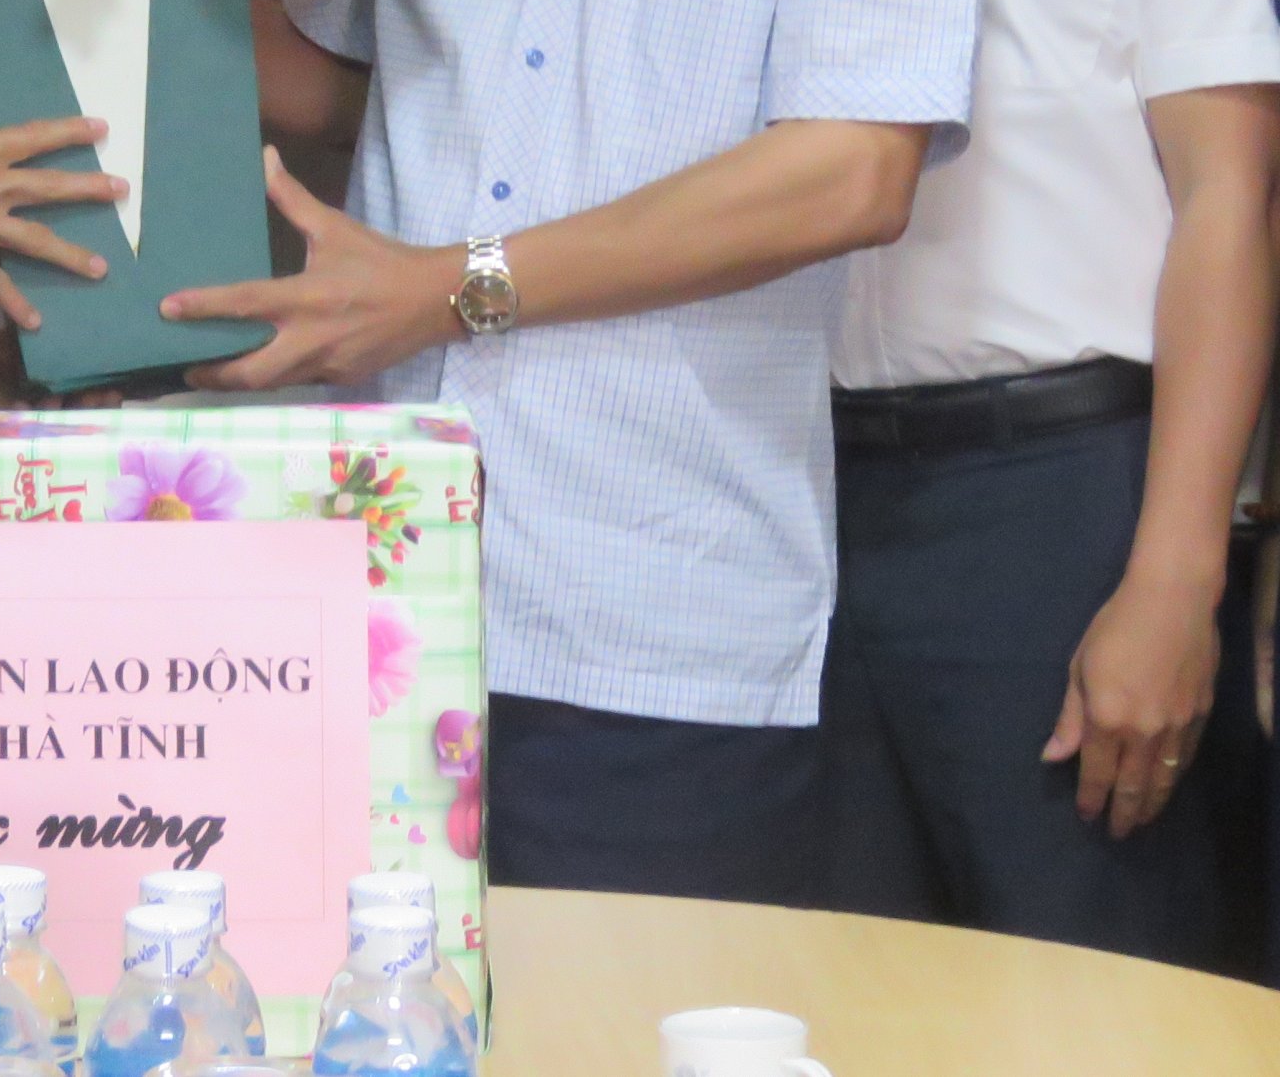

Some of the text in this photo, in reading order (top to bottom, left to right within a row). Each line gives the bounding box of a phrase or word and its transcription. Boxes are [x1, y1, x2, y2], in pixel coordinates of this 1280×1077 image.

[45, 656, 150, 694] LAO
[165, 647, 312, 703] ĐỘNG
[83, 716, 207, 760] TĨNH
[36, 793, 226, 870] mừng
